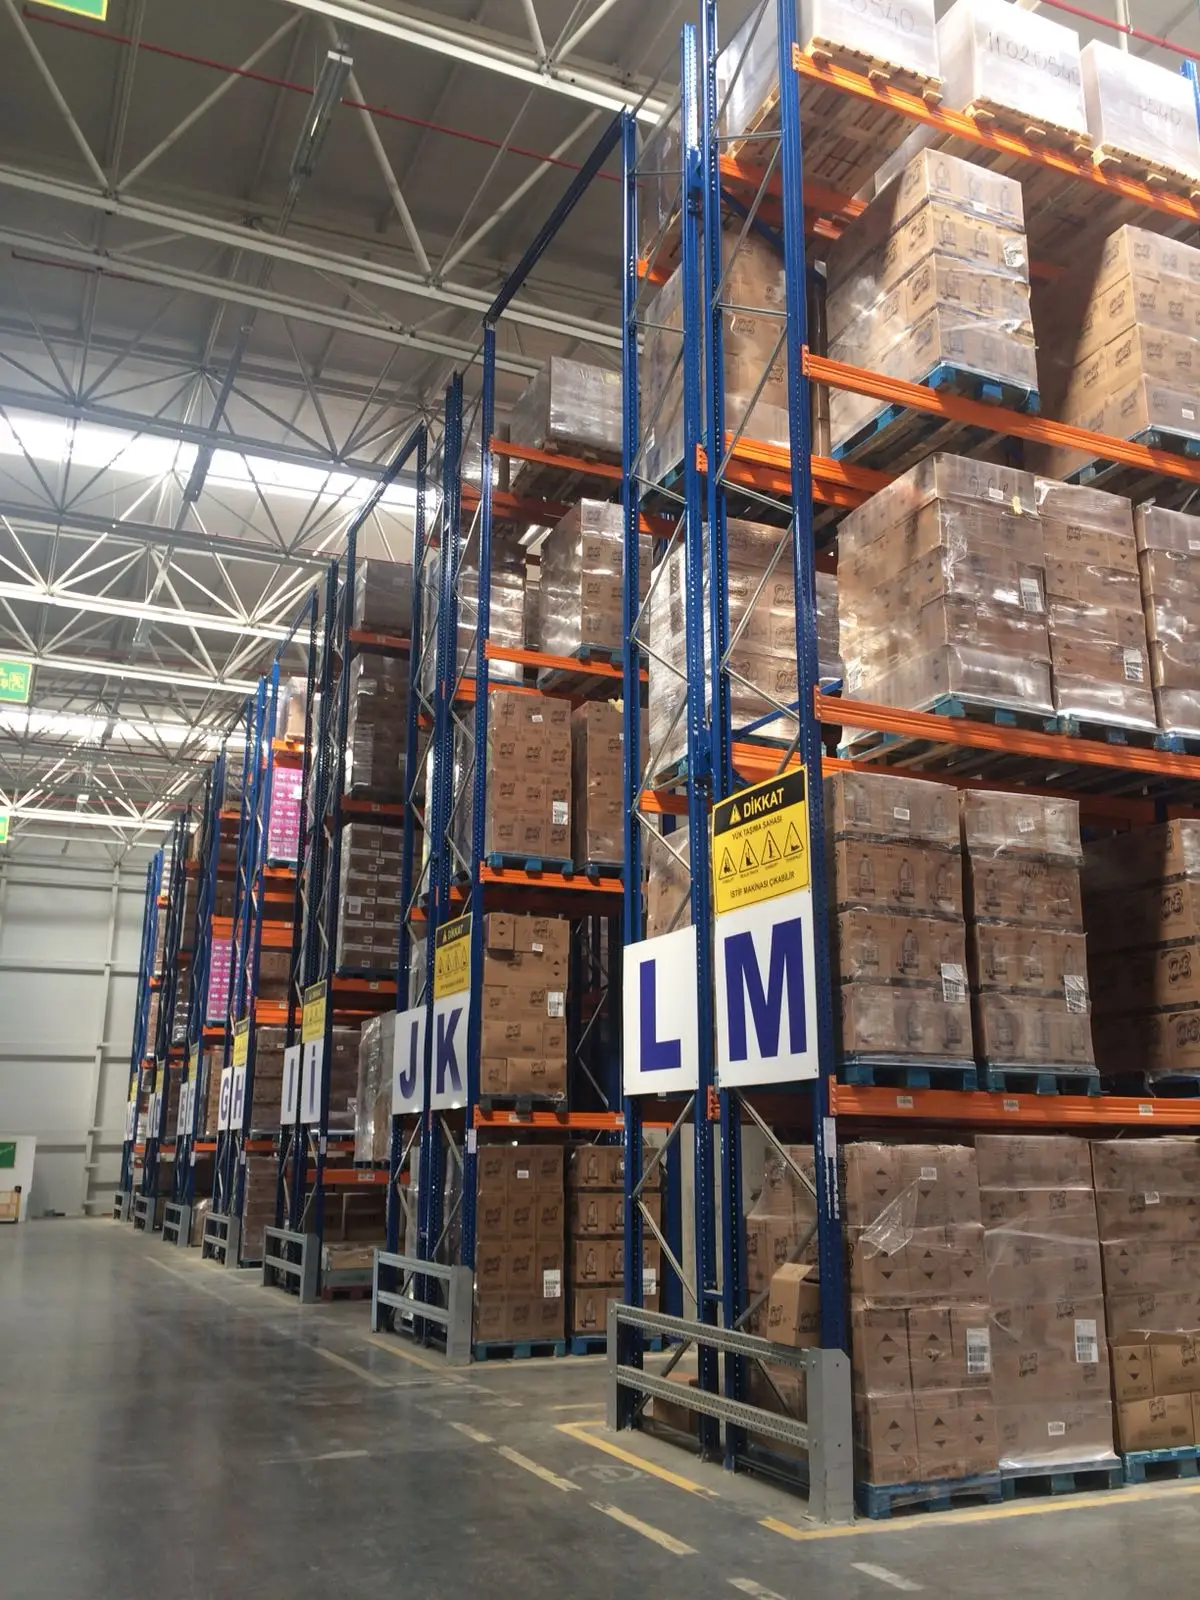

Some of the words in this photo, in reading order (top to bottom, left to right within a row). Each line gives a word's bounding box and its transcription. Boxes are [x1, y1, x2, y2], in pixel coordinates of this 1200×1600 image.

[743, 787, 785, 818] DİKKAT
[640, 958, 682, 1073] L
[724, 917, 807, 1062] M
[399, 1020, 419, 1099] J
[435, 1007, 463, 1095] K
[221, 1076, 229, 1121] G
[233, 1073, 245, 1120] H
